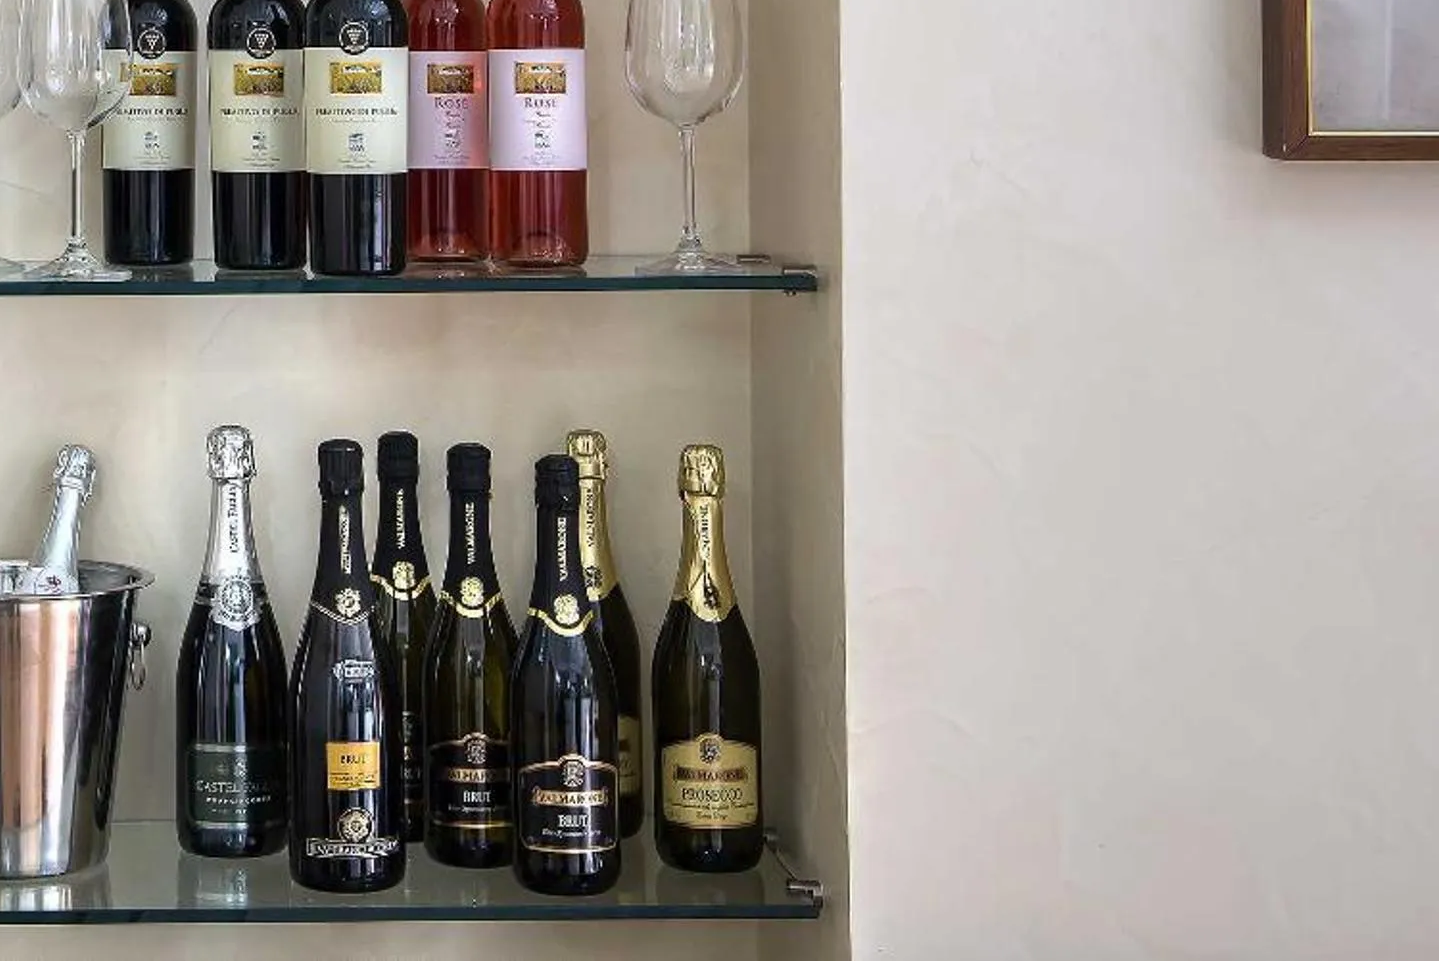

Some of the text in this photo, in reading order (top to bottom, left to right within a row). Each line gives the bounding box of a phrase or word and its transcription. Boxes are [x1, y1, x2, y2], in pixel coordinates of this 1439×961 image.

[196, 780, 240, 793] CASTEL
[463, 791, 491, 803] BRUT
[681, 787, 744, 803] PROSECCO
[557, 814, 588, 828] BRUT
